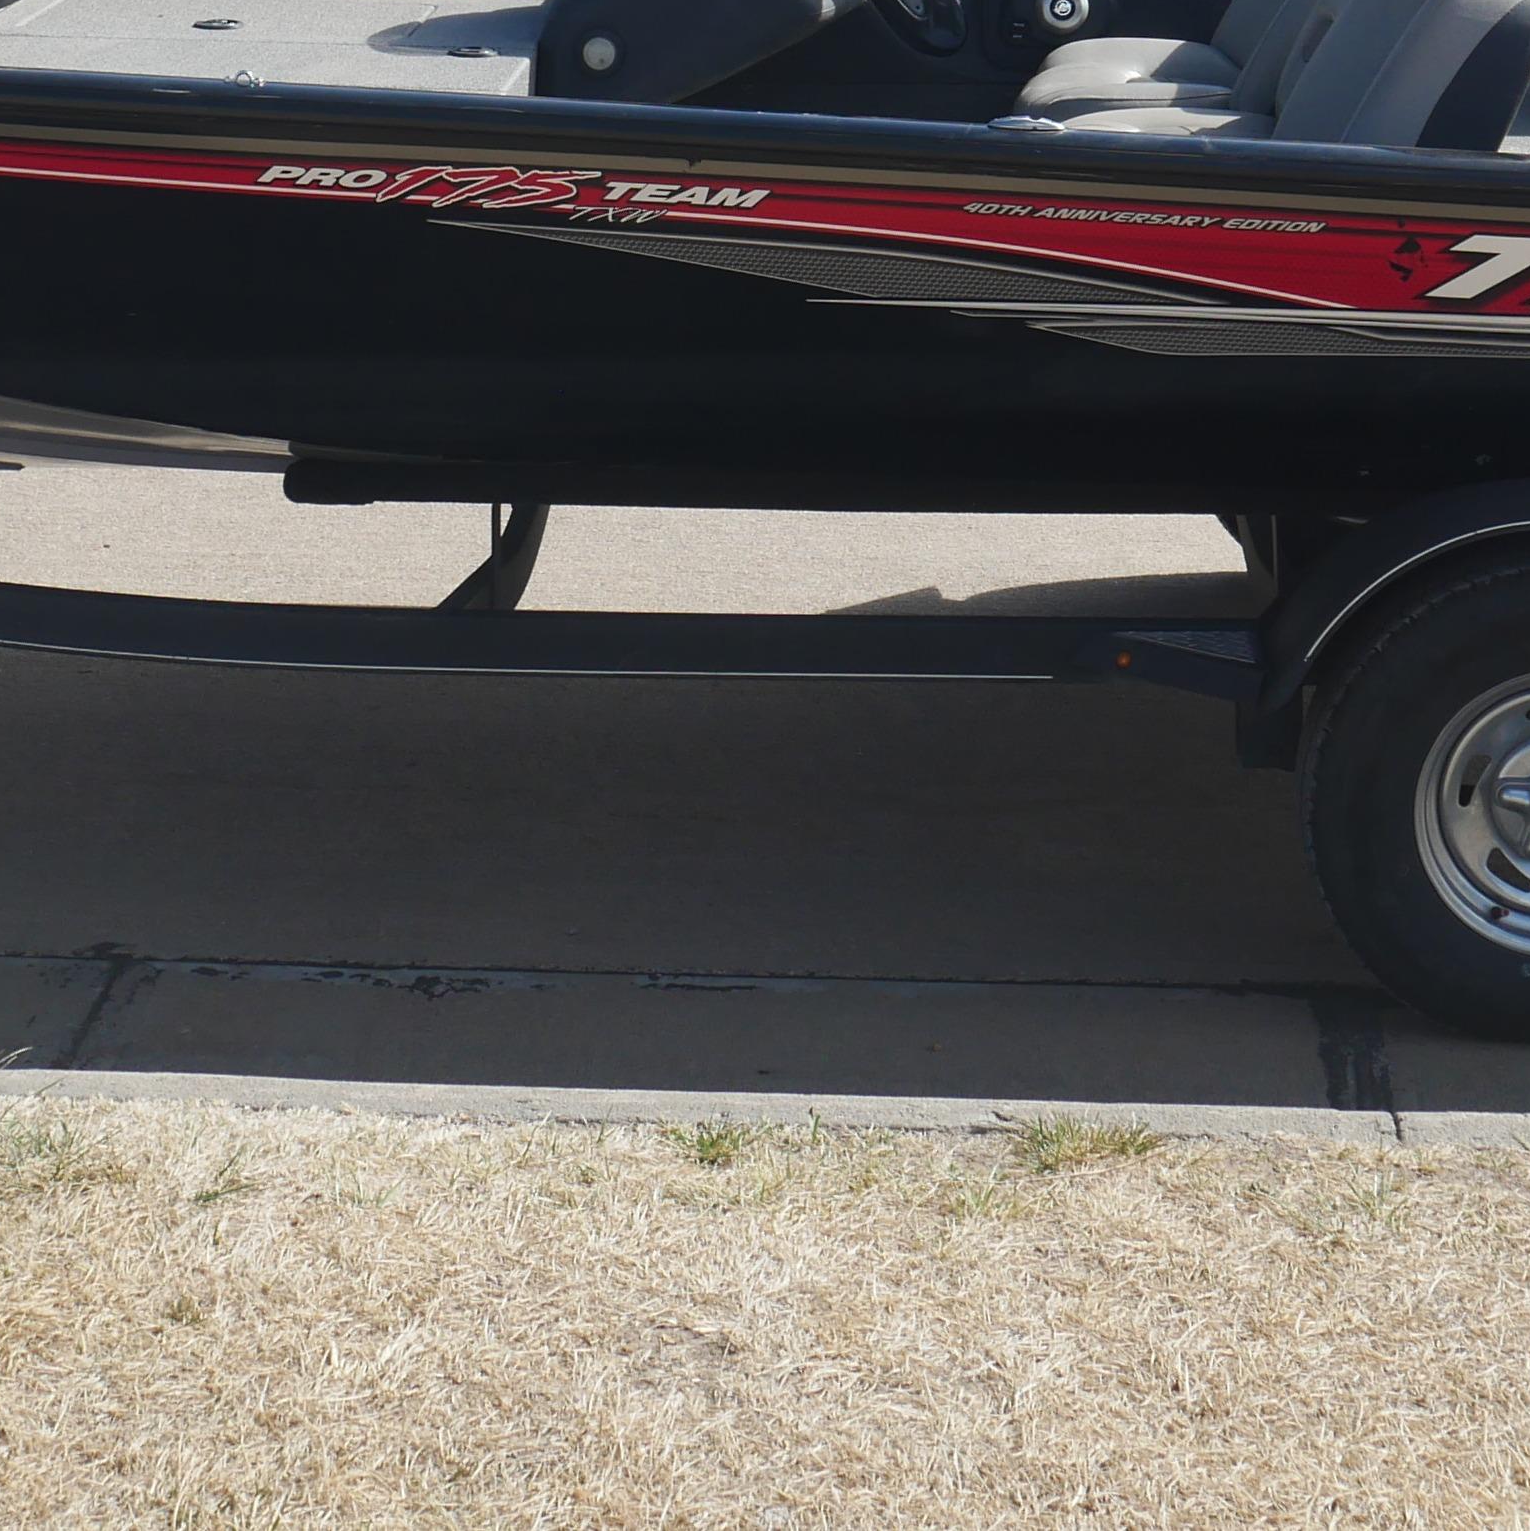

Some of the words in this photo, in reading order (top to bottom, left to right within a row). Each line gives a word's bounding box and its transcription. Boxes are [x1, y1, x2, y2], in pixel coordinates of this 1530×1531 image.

[257, 166, 387, 188] PRO
[375, 166, 601, 208] 175
[603, 181, 770, 208] TEAM
[568, 207, 669, 224] TXW
[964, 202, 1033, 217] 40TH
[1035, 206, 1222, 228] ANNIVERSARY
[1223, 218, 1326, 233] EDITION
